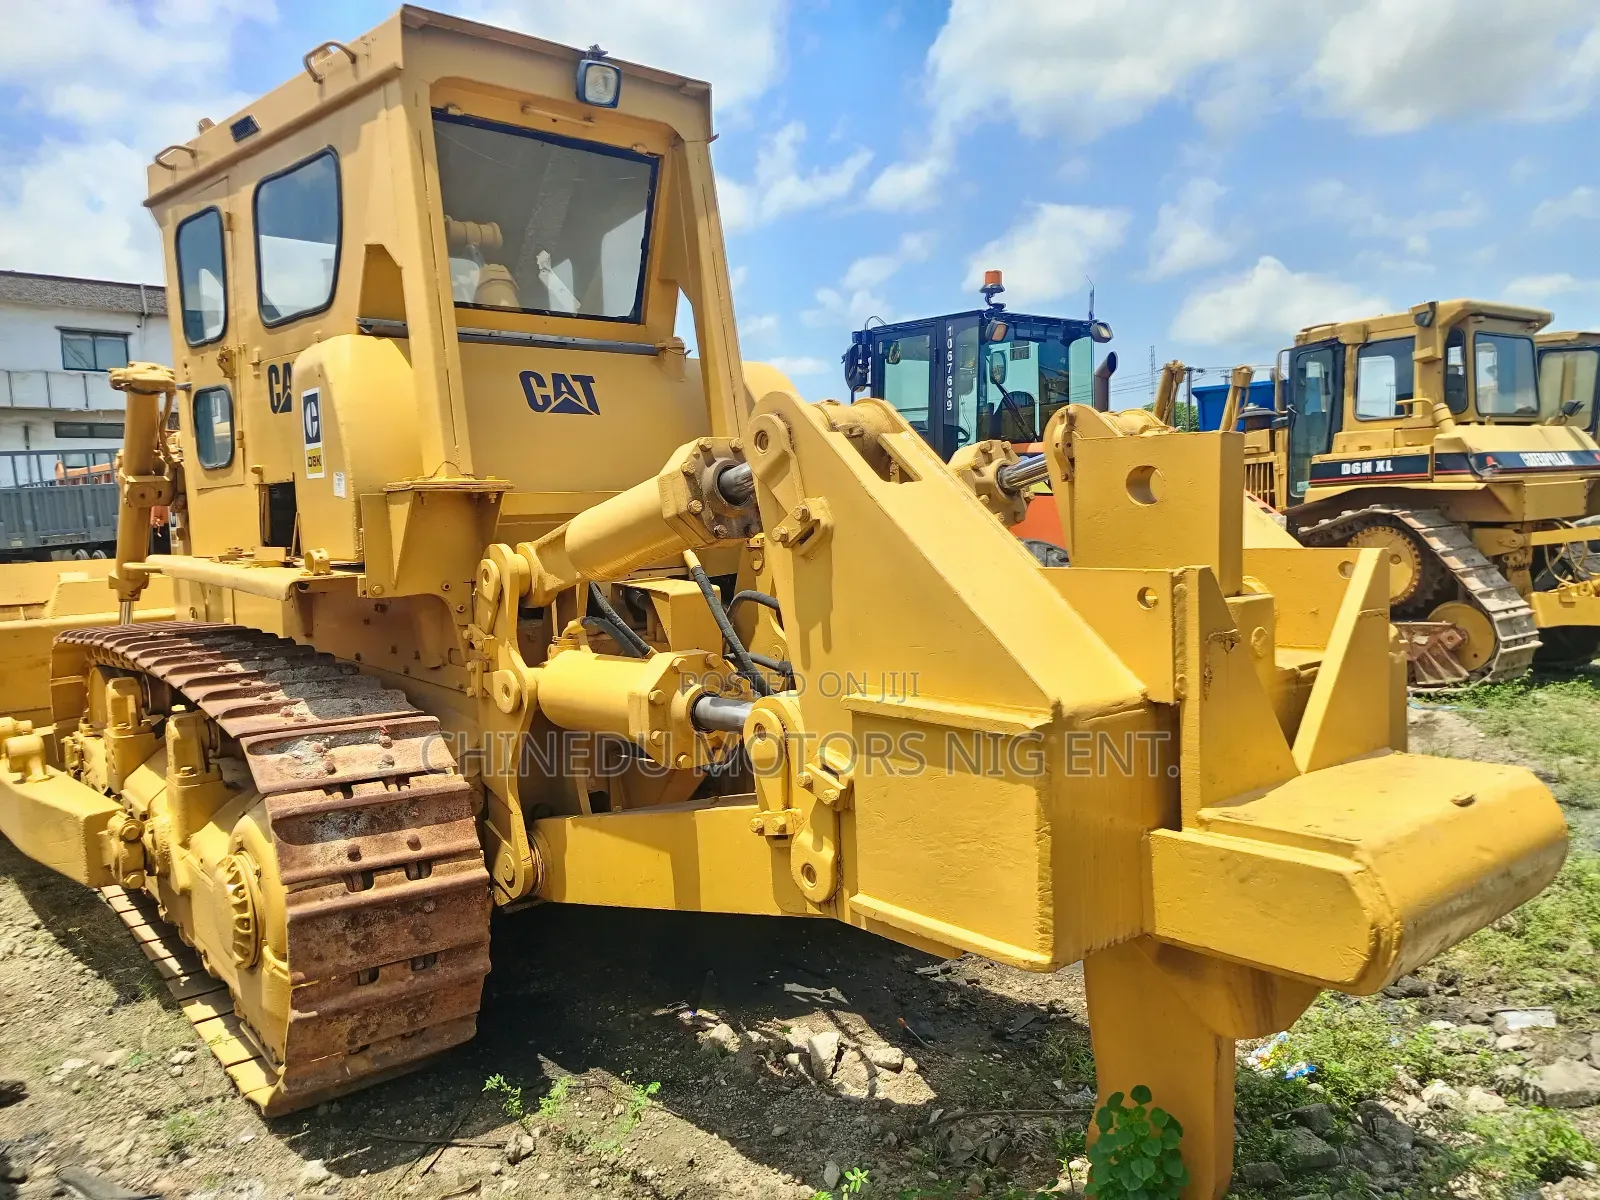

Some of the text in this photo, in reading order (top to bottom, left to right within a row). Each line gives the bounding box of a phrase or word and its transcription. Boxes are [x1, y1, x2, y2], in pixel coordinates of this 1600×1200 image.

[268, 362, 292, 414] CA
[518, 370, 601, 415] CAT
[1341, 459, 1394, 475] D6H XL
